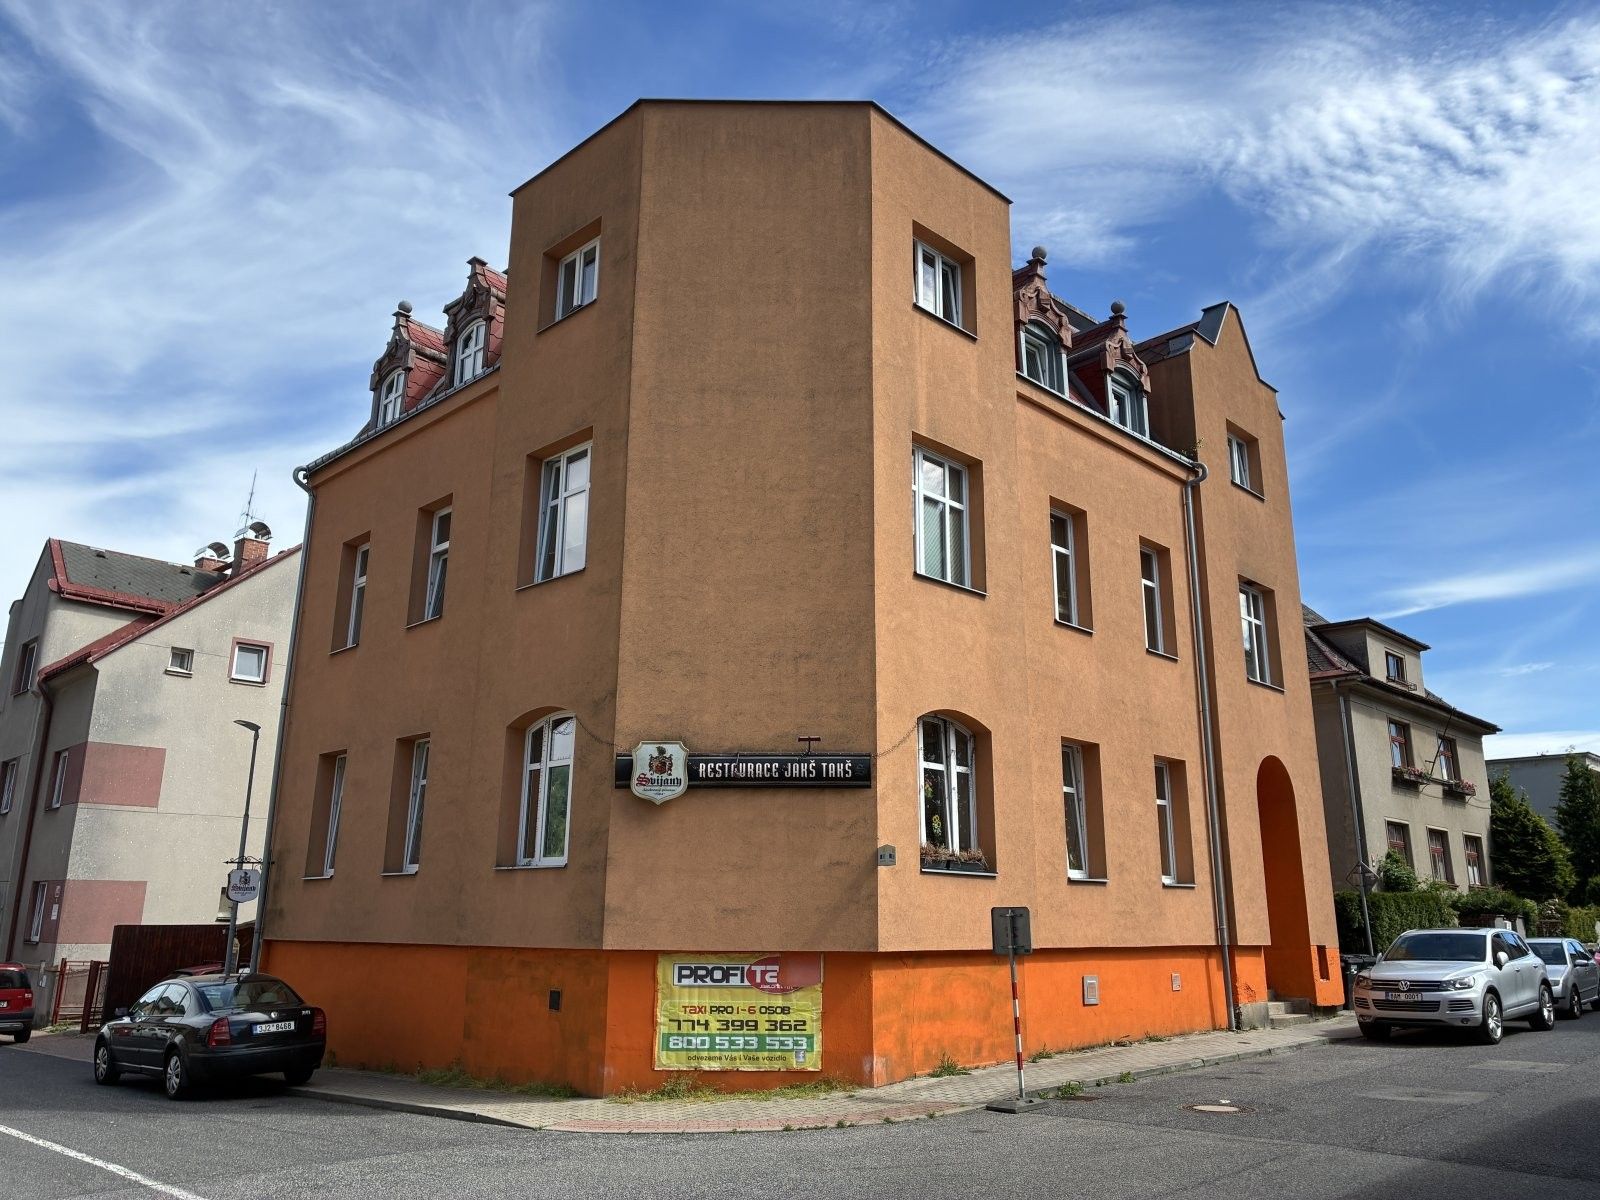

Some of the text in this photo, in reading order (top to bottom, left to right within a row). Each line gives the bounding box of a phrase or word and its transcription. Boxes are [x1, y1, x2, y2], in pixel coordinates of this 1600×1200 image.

[784, 760, 816, 778] JAKŠ
[821, 760, 852, 778] TAKŠ
[636, 772, 682, 787] Svijany
[677, 965, 745, 984] PROFI
[709, 1005, 734, 1015] PRO
[759, 1005, 791, 1015] OSOB
[669, 1019, 807, 1031] 774 399 362
[669, 1036, 807, 1050] 800 533 533
[724, 1054, 737, 1062] Vás
[743, 1054, 760, 1062] Vaše
[761, 1054, 787, 1062] vozidlo
